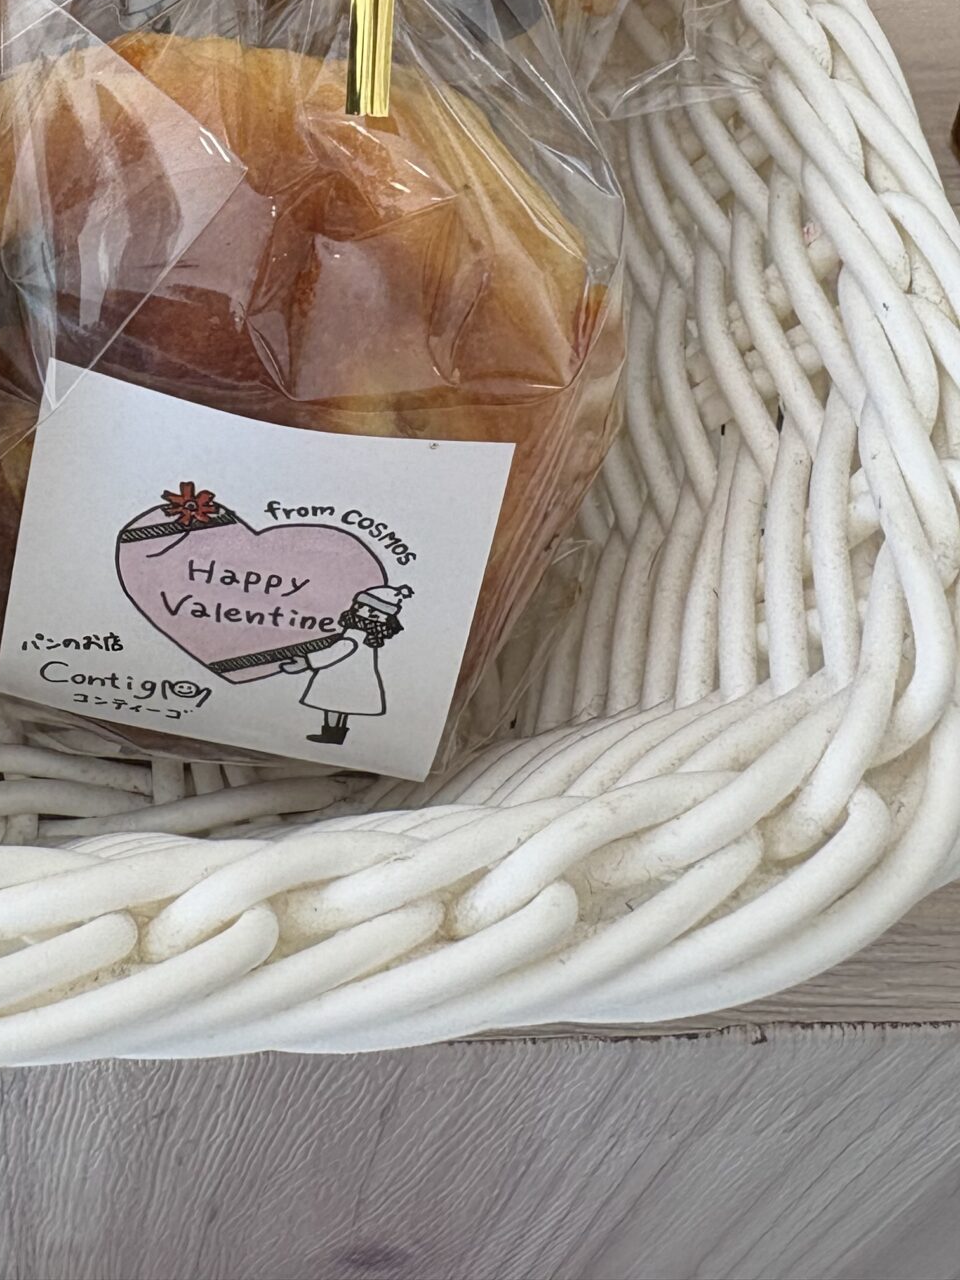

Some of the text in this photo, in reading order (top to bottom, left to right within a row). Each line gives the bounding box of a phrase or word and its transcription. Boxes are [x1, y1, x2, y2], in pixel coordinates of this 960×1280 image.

[264, 500, 418, 566] from COSMOS
[187, 559, 311, 598] Happy
[159, 590, 338, 633] Valentine
[20, 631, 125, 652] パンのお店
[72, 692, 194, 720] コンティーゴ
